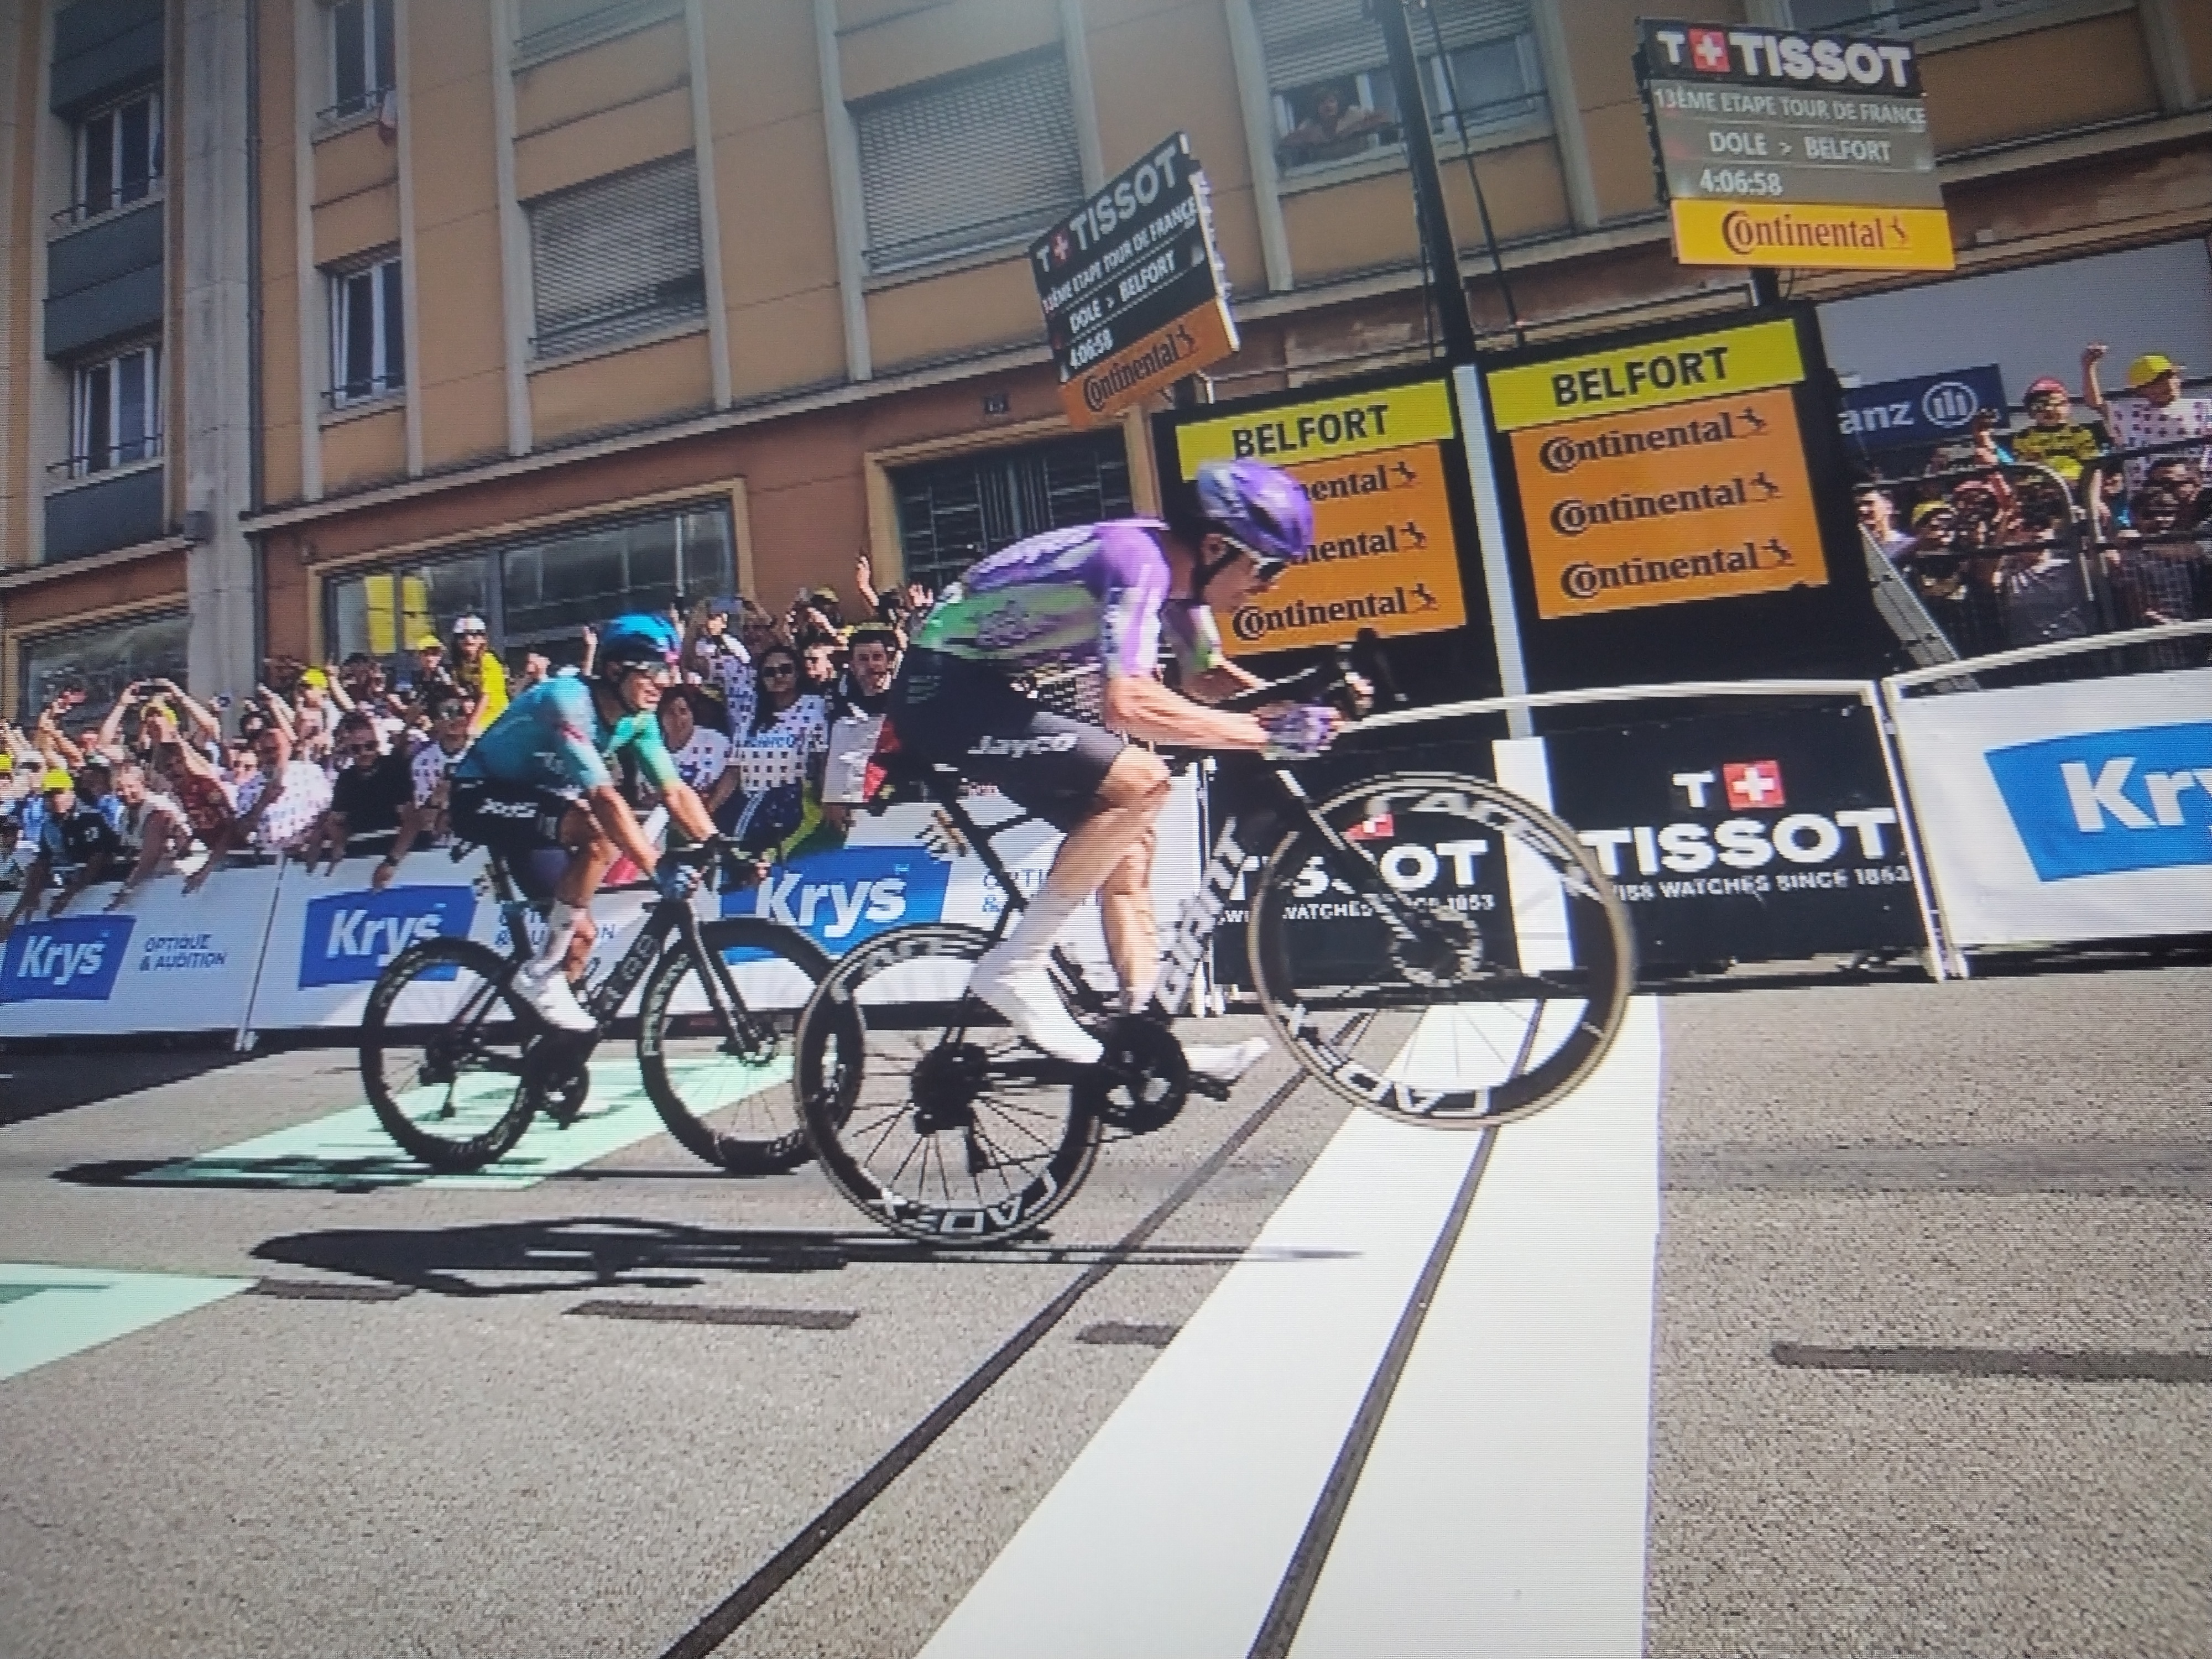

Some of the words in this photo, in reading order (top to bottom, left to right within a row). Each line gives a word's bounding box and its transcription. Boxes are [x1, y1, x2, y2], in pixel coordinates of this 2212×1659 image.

[1729, 32, 1911, 88] TISSOT
[1782, 96, 1827, 119] TOUR
[1835, 100, 1856, 121] DE
[1860, 103, 1926, 126] FRANCE
[1709, 131, 1767, 156] DOLE
[1803, 136, 1891, 161] BELFORT
[1070, 144, 1176, 251] TISSOT
[1699, 169, 1783, 196] 4:06:58
[1102, 239, 1134, 273] TOUR
[1149, 195, 1198, 242] FRANCE
[1721, 210, 1885, 255] Continental
[1070, 298, 1102, 334] DOLE
[1118, 250, 1176, 302] BELFORT
[1082, 336, 1181, 412] Continental
[1552, 347, 1729, 407] BELFORT
[1233, 404, 1388, 459] BELFORT
[1540, 412, 1736, 473] Continental
[1550, 478, 1746, 536] Continental
[1561, 542, 1761, 599] Continental
[1233, 587, 1407, 641] Continental
[2060, 757, 2212, 832] Kr
[1577, 807, 1896, 877] TISSOT
[755, 872, 907, 938] Krys
[1659, 875, 1771, 899] WATCHES
[1775, 868, 1850, 892] SINCE
[16, 935, 107, 986] Krys
[326, 909, 443, 967] Krys
